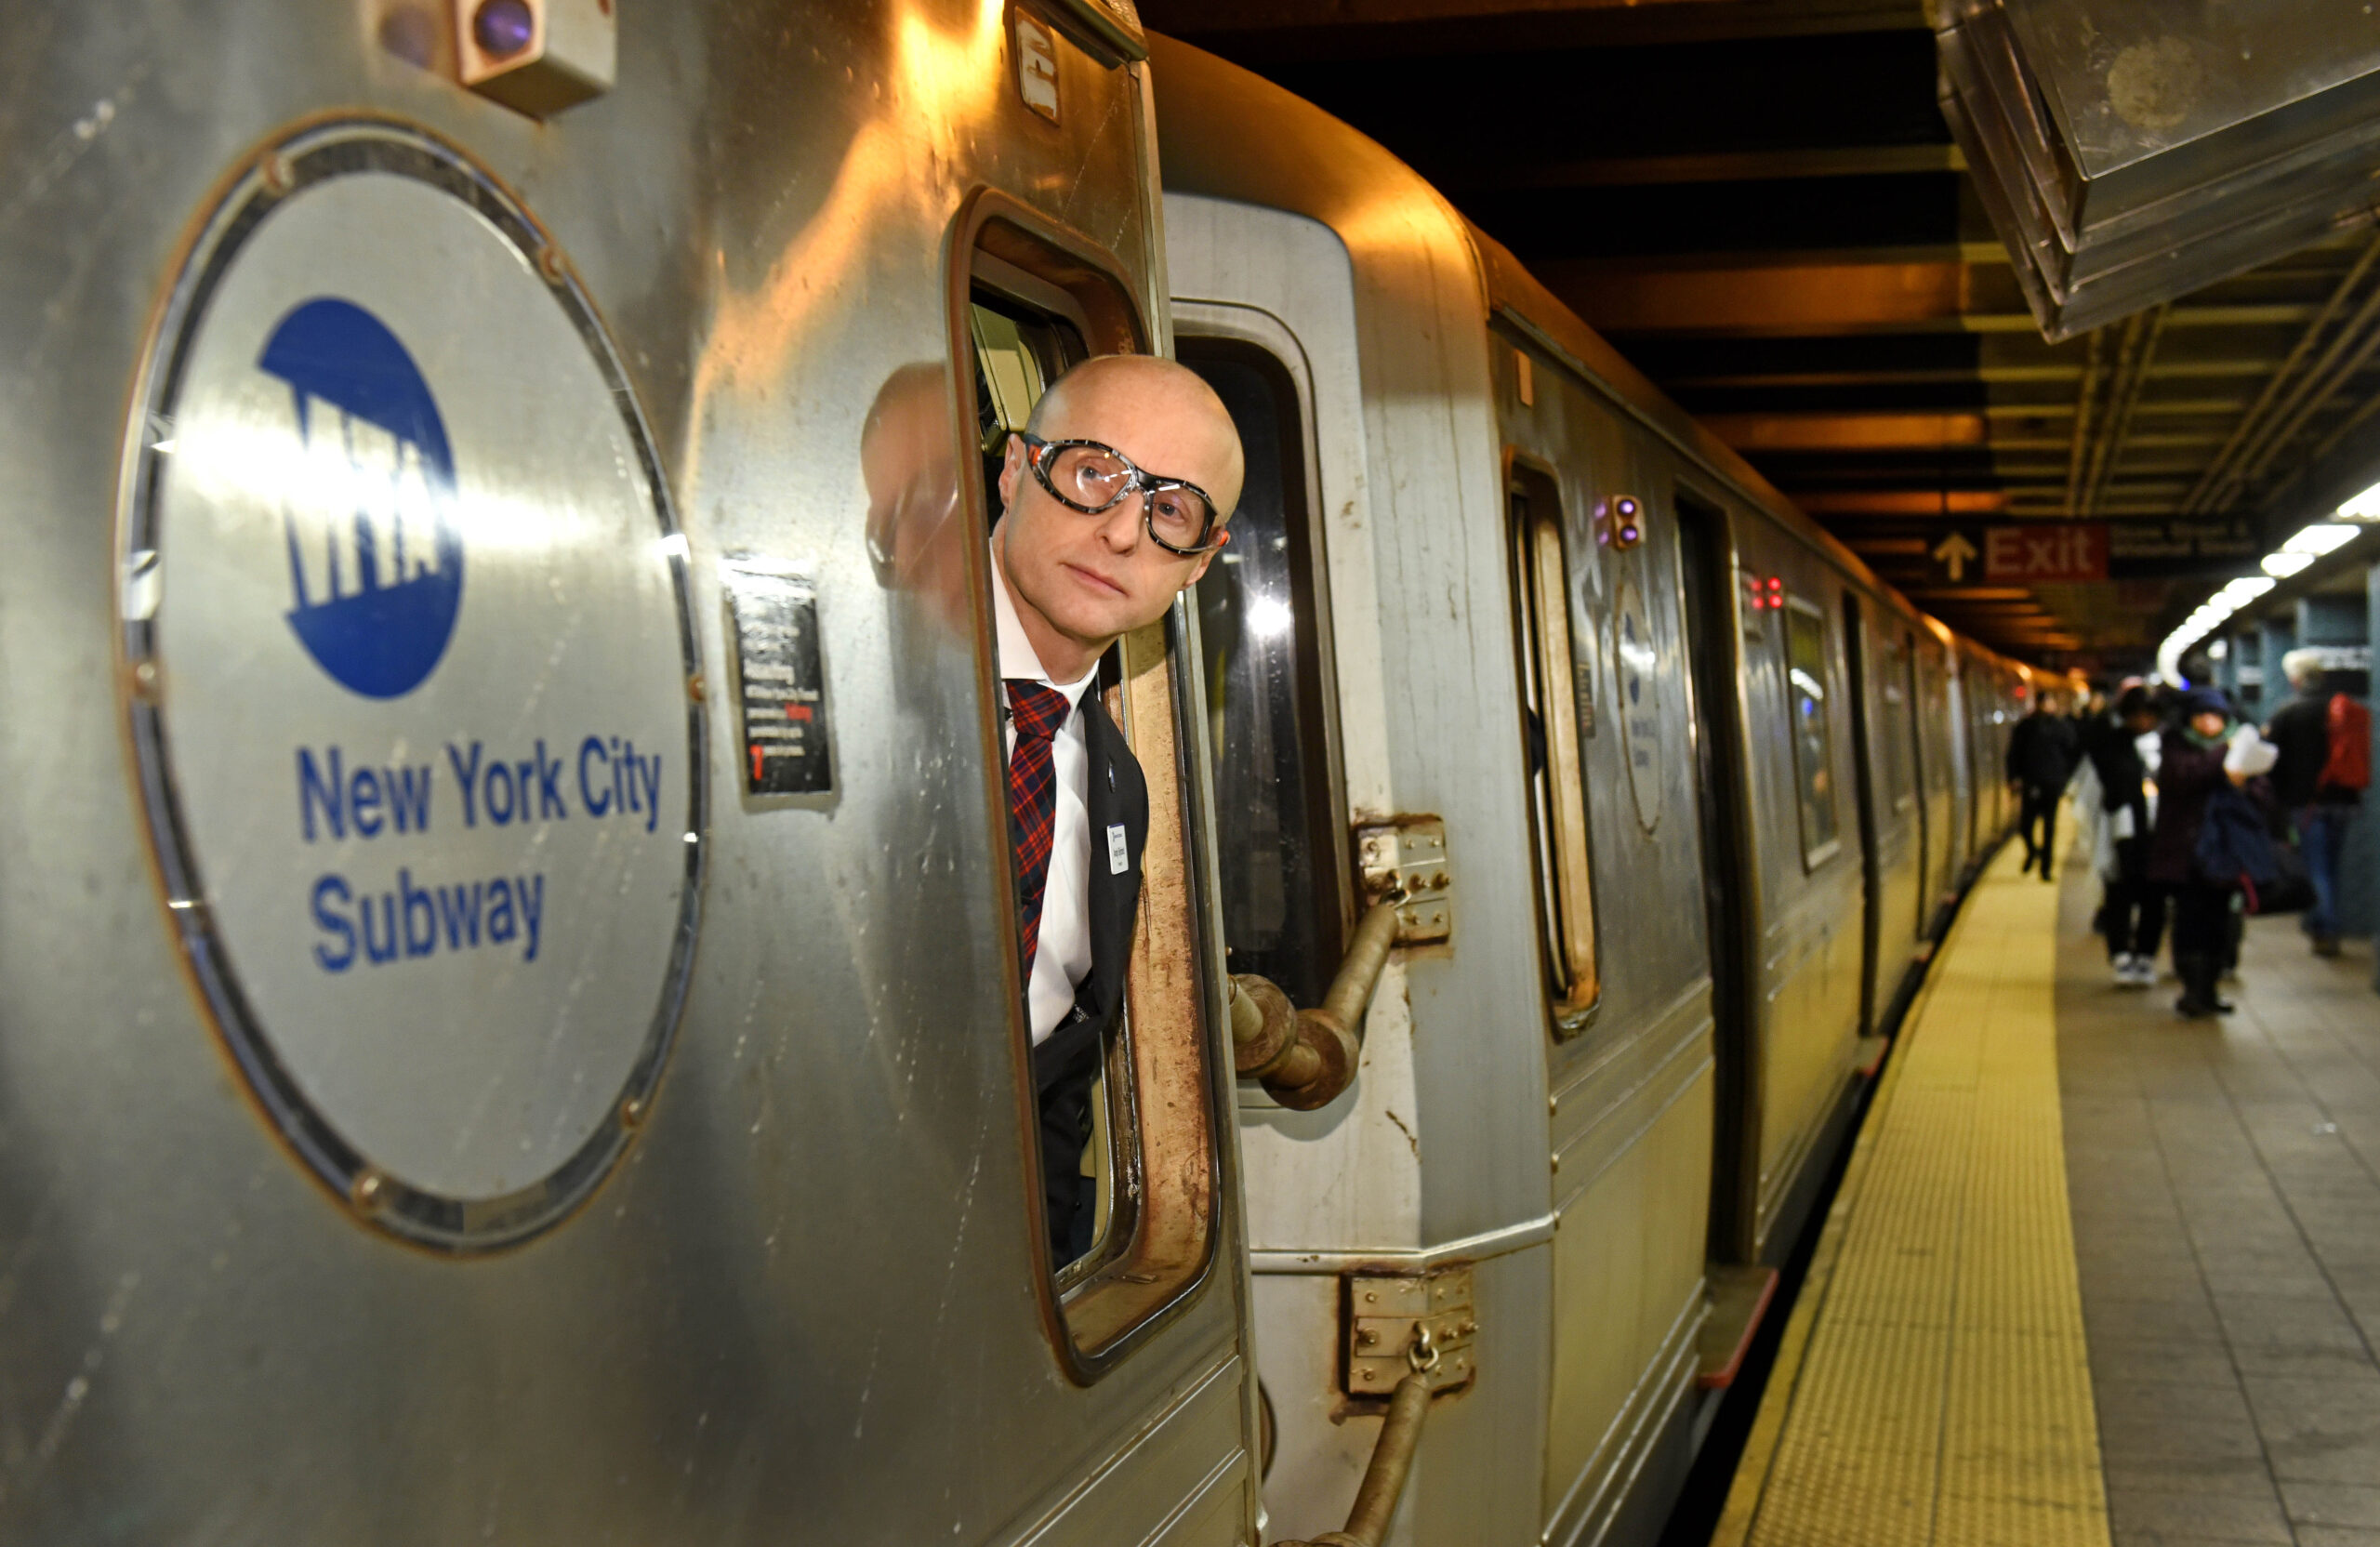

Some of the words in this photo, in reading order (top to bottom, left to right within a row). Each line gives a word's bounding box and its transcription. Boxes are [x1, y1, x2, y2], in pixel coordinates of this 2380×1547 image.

[1986, 527, 2092, 575] Exit
[297, 745, 432, 842] New
[444, 739, 567, 827] York
[576, 734, 662, 833] City
[311, 866, 546, 973] Subway
